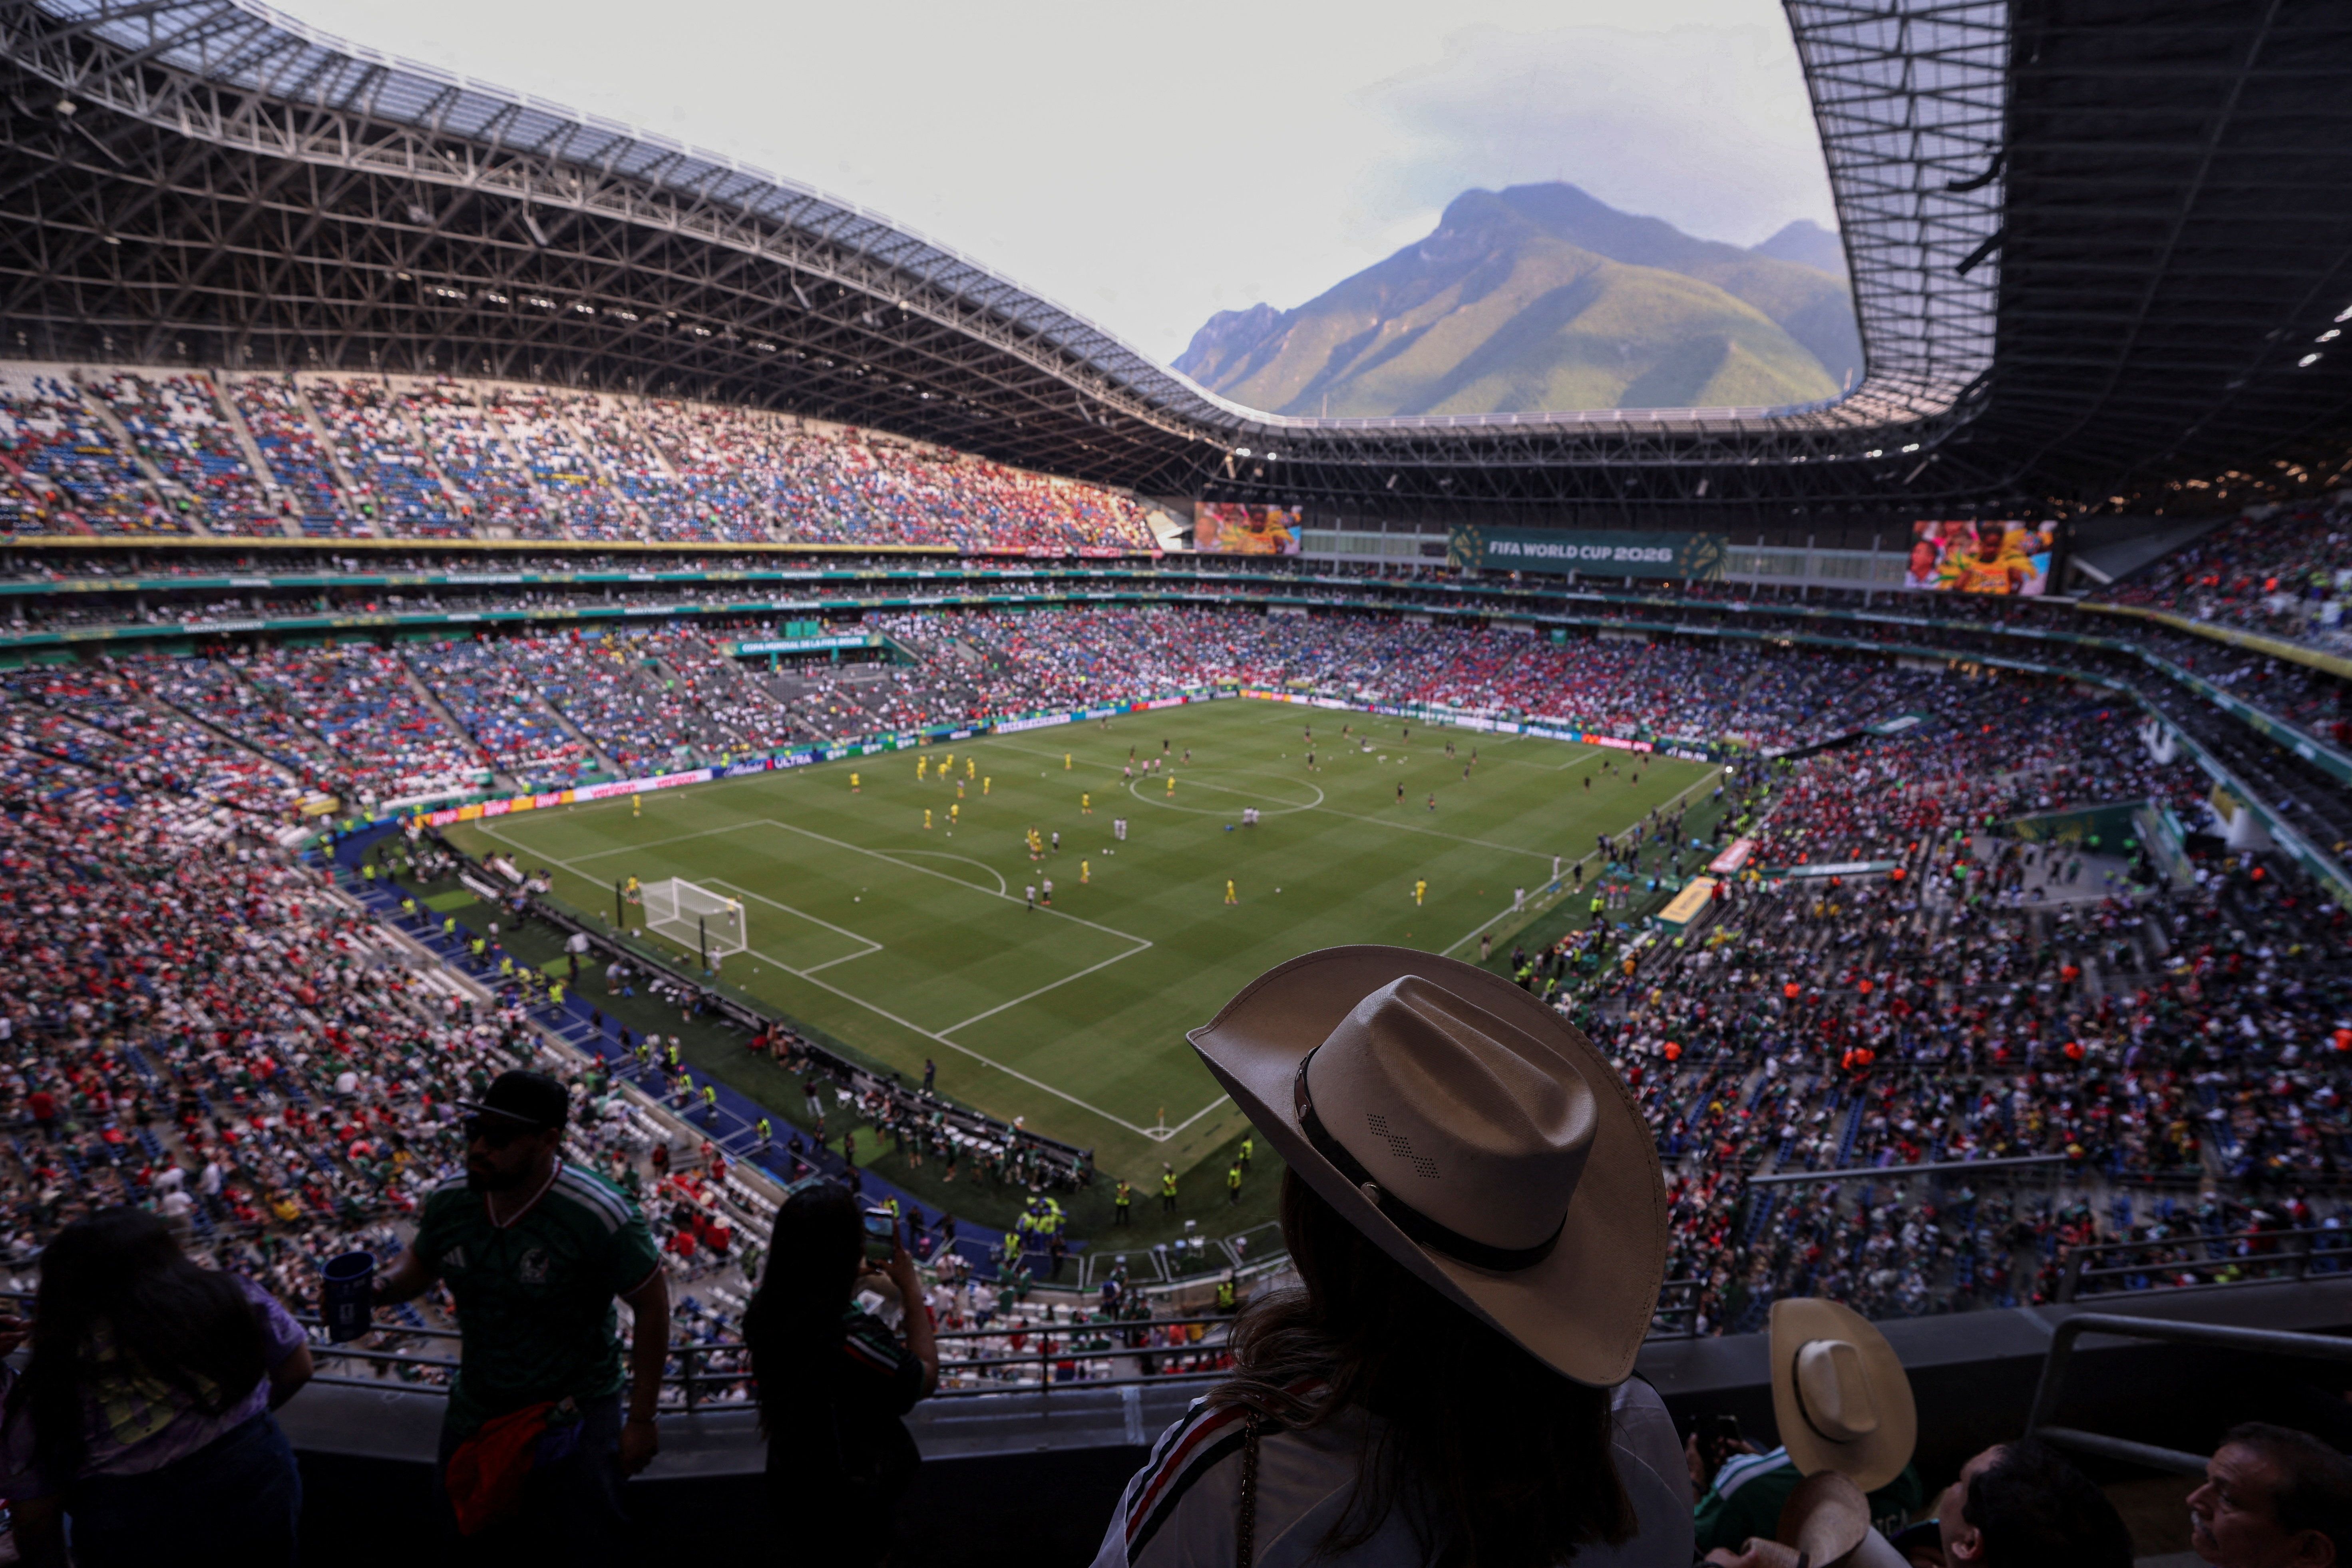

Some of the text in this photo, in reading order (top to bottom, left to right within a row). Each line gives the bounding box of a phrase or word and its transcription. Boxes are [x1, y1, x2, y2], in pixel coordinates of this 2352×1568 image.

[1489, 540, 1673, 562] FIFA WORLD CUP 2026
[742, 643, 764, 652] COPA
[765, 640, 799, 651] MUNDIAL
[800, 640, 810, 648] DE
[810, 639, 820, 647] LA
[821, 638, 836, 647] FIFA
[774, 754, 813, 769] ULTRA
[655, 773, 697, 788] verizon
[590, 783, 636, 798] verizon
